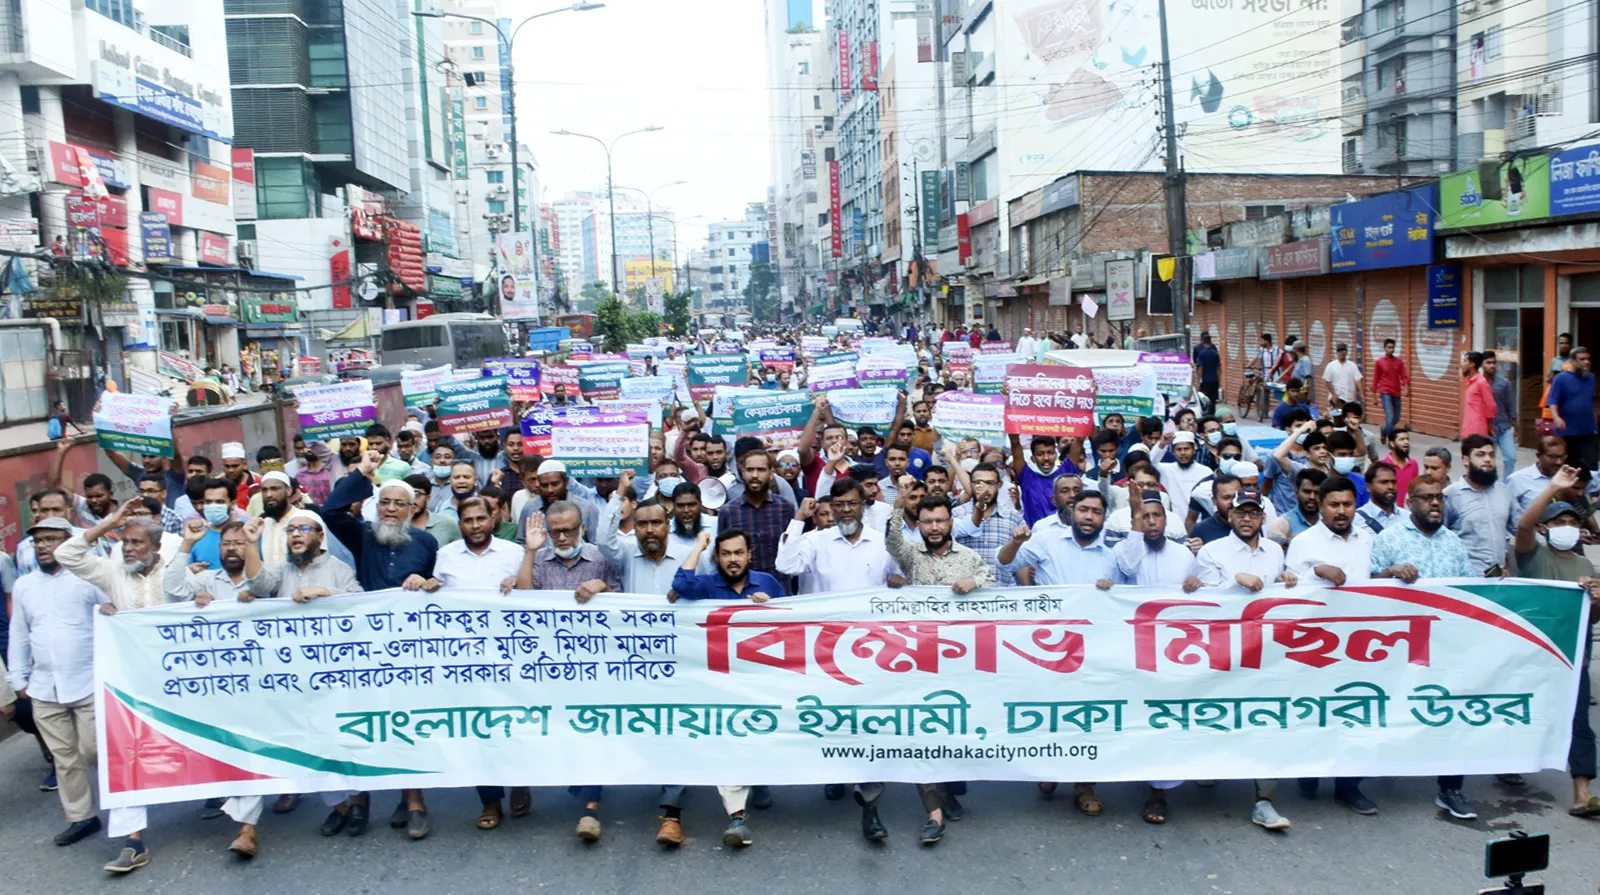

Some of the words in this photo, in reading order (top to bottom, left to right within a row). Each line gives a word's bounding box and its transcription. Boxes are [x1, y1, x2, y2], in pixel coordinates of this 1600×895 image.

[1009, 388, 1031, 406] দিতে
[1033, 394, 1053, 408] হবে
[1077, 397, 1094, 409] দাও
[869, 596, 951, 616] বিসমিল্লাহির
[955, 595, 1018, 614] রাহমানির
[1023, 595, 1063, 613] রাহীম
[156, 615, 242, 644] আমীরে
[252, 613, 356, 639] জামায়াত
[500, 608, 610, 630] রহমানসহ
[620, 608, 678, 628] সকল
[696, 605, 1093, 686] বিক্ষোভ
[1124, 597, 1442, 673] মিছিল
[162, 639, 265, 671] নেতাকর্মী
[275, 646, 292, 664] ও
[300, 636, 488, 664] আলেম-ওলামাদের
[553, 629, 608, 655] মিথ্যা
[614, 632, 678, 655] মামলা
[163, 673, 250, 698] প্রত্যাহার
[259, 673, 303, 692] এবং
[309, 662, 435, 691] কেয়ারটেকার
[441, 664, 513, 684] সরকার
[520, 653, 599, 682] প্রতিষ্ঠার
[606, 653, 678, 681] দাবিতে
[336, 703, 551, 747] বাংলাদেশ
[566, 703, 782, 741] জামায়াতে
[797, 690, 987, 741] ইসলামী,
[1003, 699, 1128, 734] ঢাকা
[1144, 682, 1390, 731] মহানগরী
[1408, 684, 1534, 728] উত্তর
[822, 742, 1098, 761] www.jamaatdhakacitynorth.org
